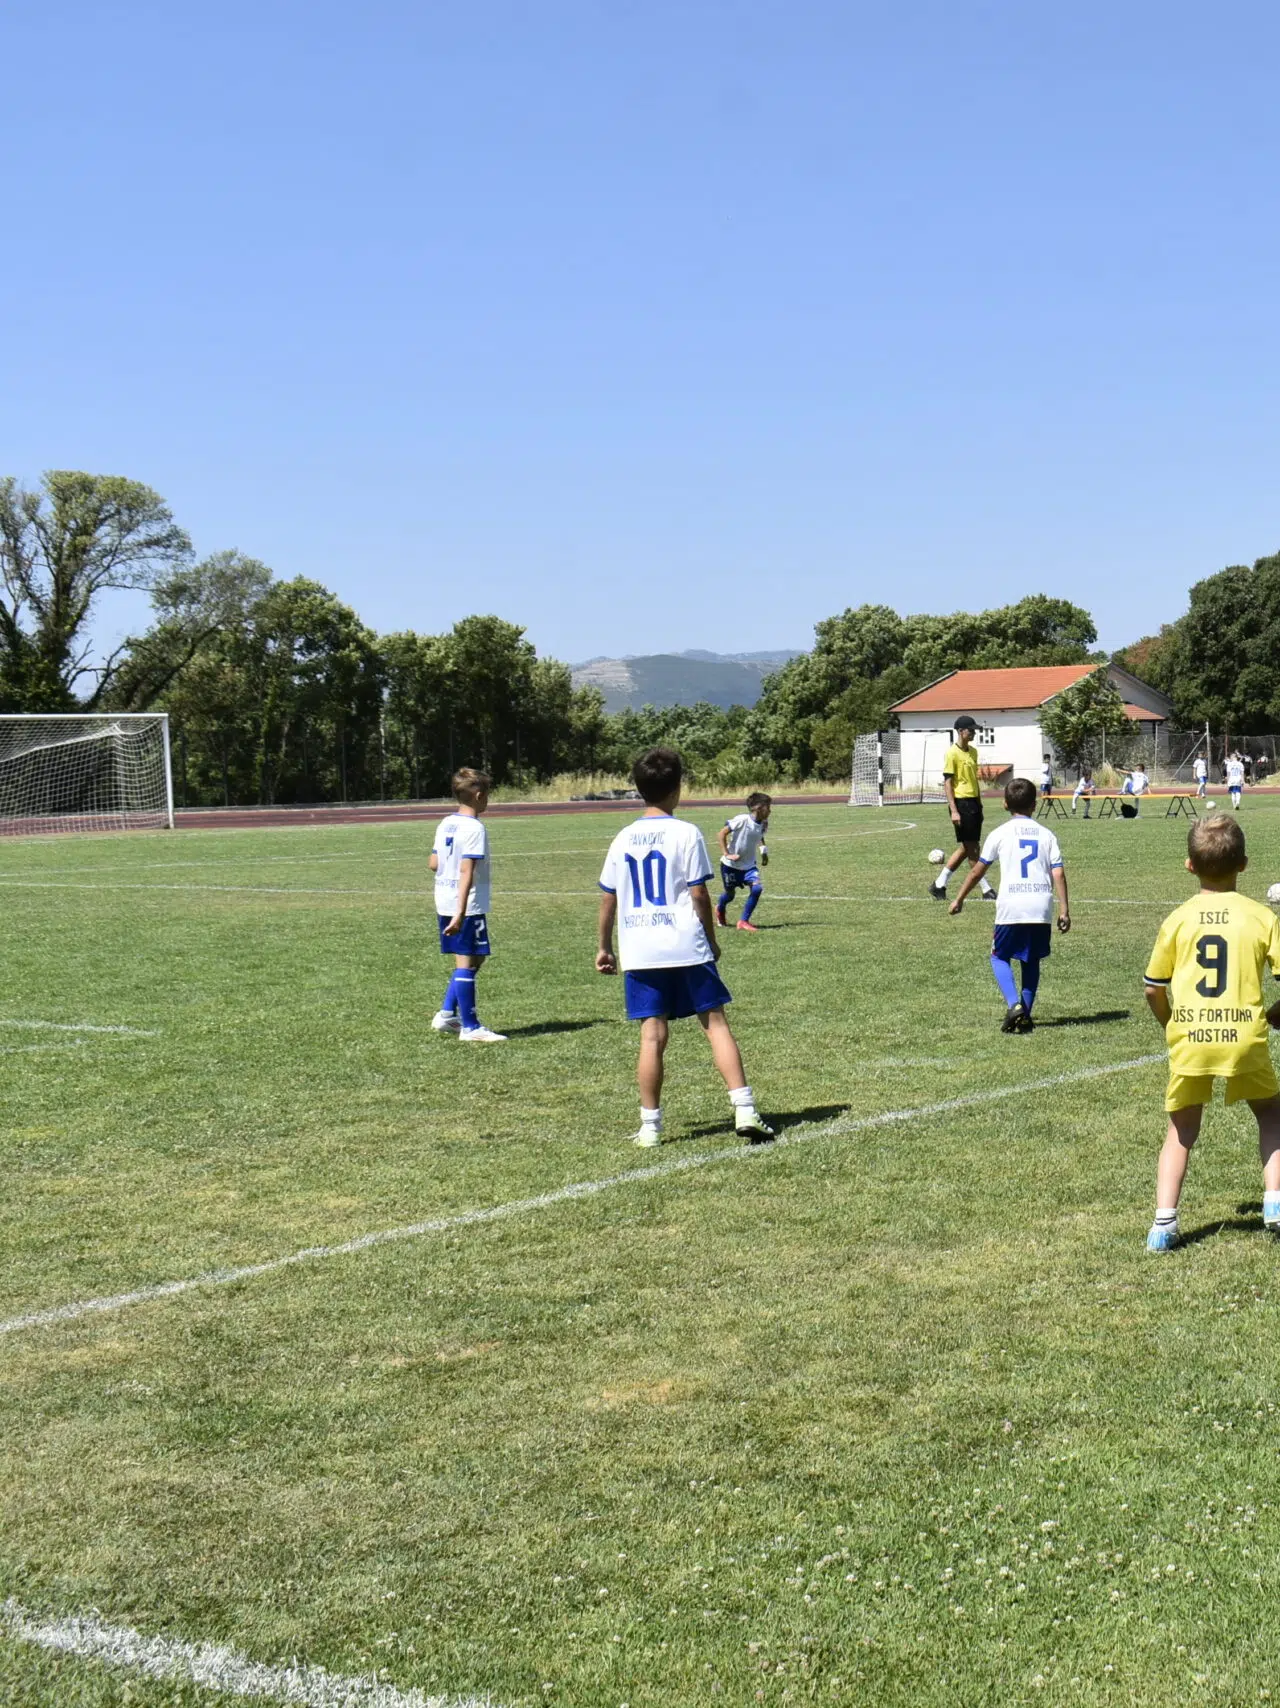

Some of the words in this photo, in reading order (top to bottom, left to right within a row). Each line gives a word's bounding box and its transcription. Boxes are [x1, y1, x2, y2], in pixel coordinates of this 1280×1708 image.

[1019, 838, 1038, 878] 7
[624, 849, 668, 908] 10
[1195, 934, 1228, 998] 9
[1173, 1005, 1194, 1023] UŠS
[1199, 1008, 1253, 1023] FORTUNA
[1188, 1028, 1238, 1043] MOSTAR
